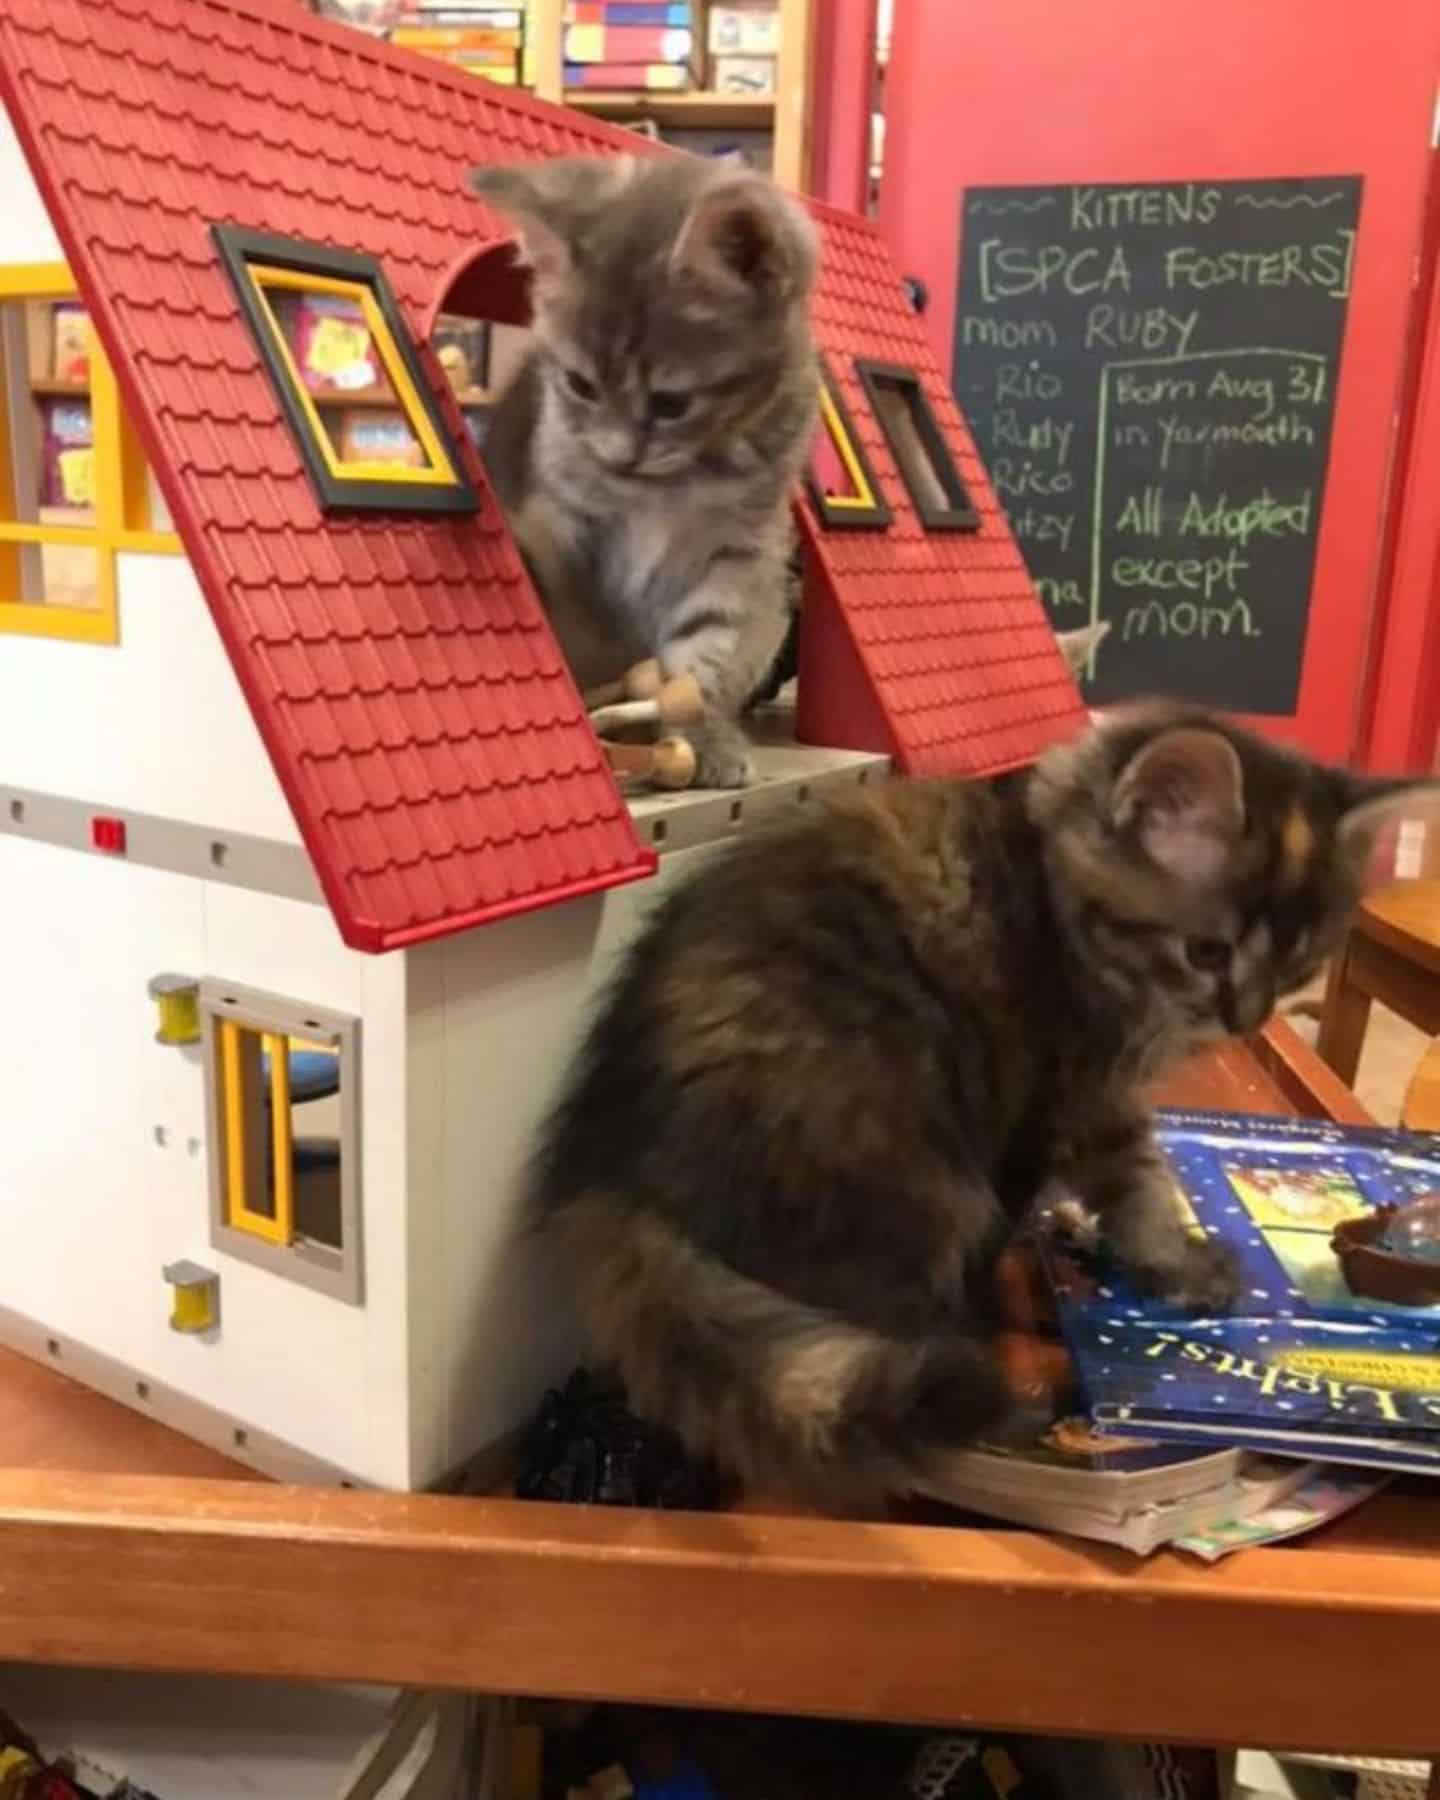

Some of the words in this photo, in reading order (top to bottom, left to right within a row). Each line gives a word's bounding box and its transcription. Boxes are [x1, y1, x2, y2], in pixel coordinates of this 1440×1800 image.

[1071, 184, 1222, 230] KITTENS
[1085, 303, 1198, 356] RUBY
[996, 361, 1062, 403] Rio
[1117, 373, 1196, 405] Born
[1207, 371, 1275, 420] Aug
[1288, 365, 1327, 405] 31
[1115, 424, 1148, 447] in
[1157, 413, 1314, 469] Yarmouth
[992, 458, 1073, 496] Rico
[1116, 487, 1161, 537] All
[1179, 484, 1311, 548] Adopted
[1112, 549, 1248, 597] except
[1145, 1331, 1408, 1424] Lights!
